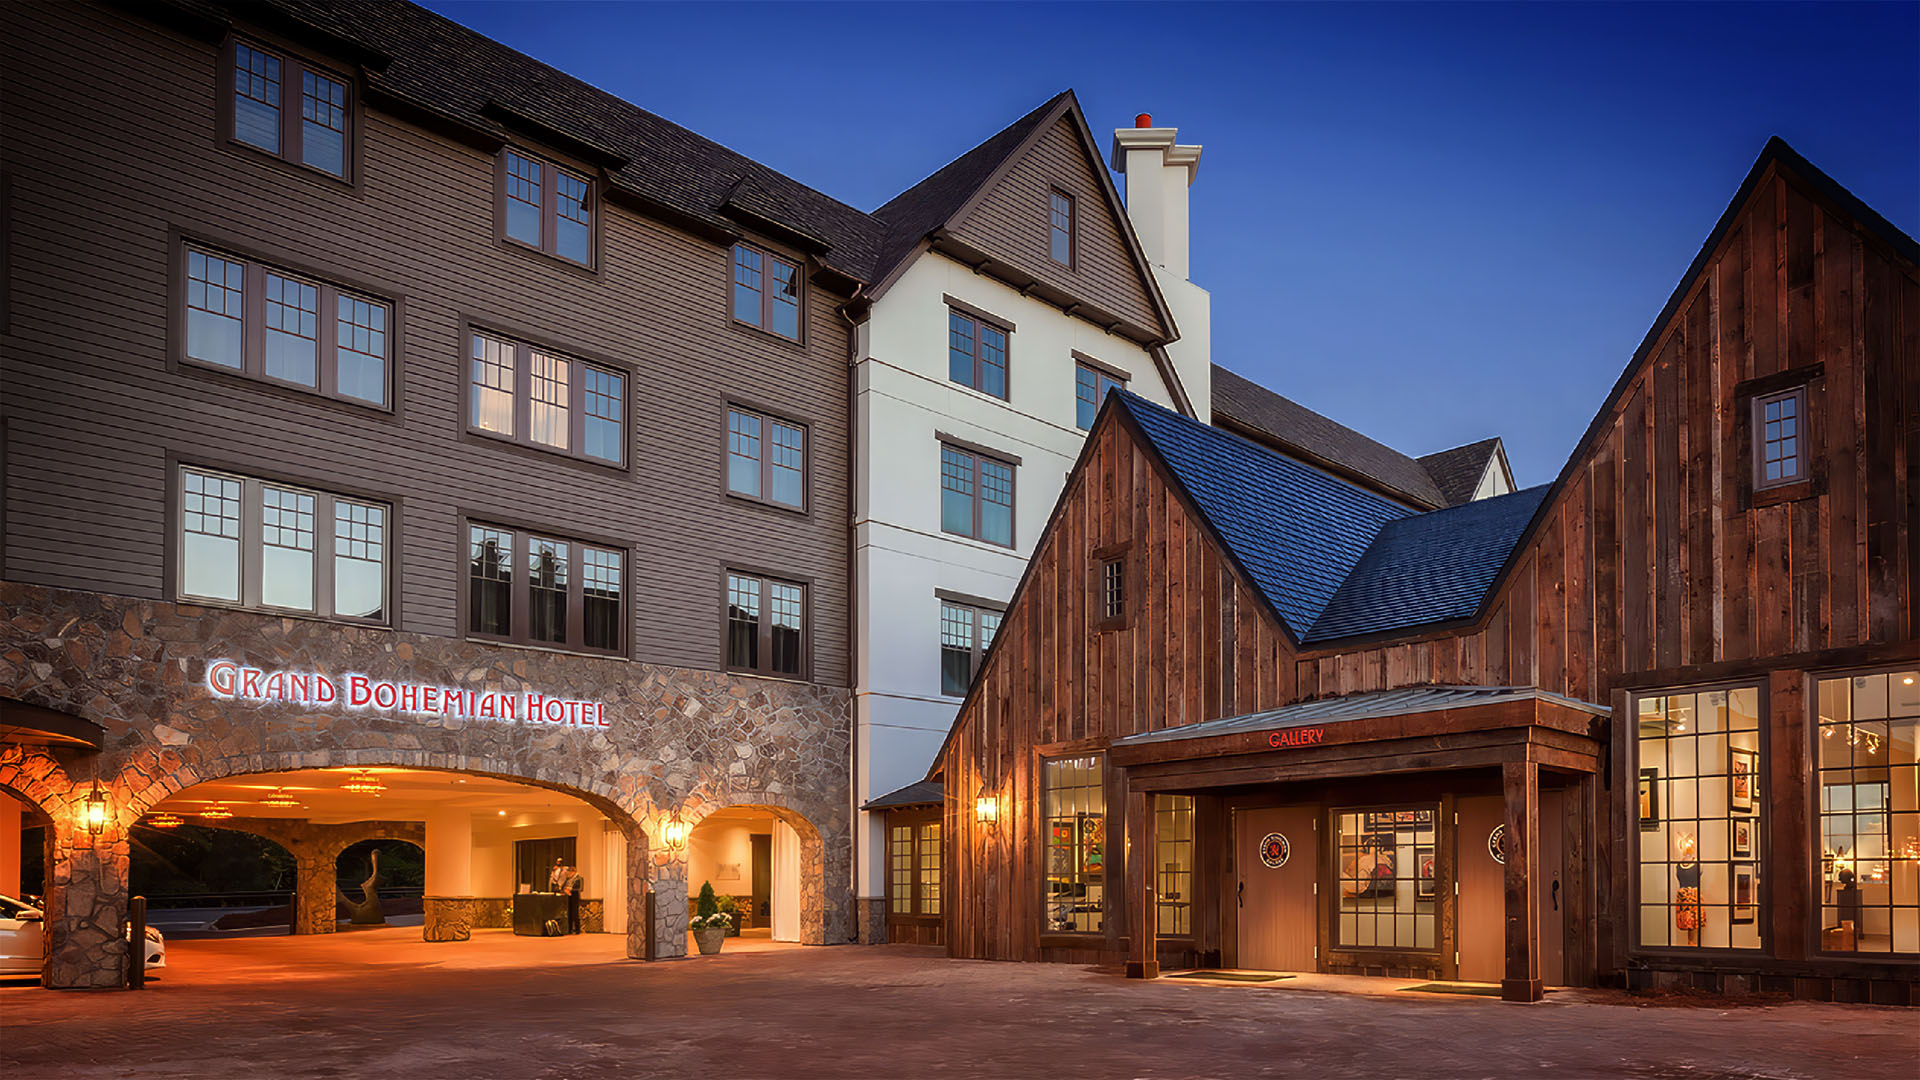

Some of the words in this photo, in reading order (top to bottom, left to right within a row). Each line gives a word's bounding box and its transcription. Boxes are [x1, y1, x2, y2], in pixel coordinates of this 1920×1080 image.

[209, 662, 336, 702] GRAND
[349, 675, 517, 720] BOHEMIAN
[526, 693, 611, 727] HOTEL
[1269, 729, 1324, 747] GALLERY
